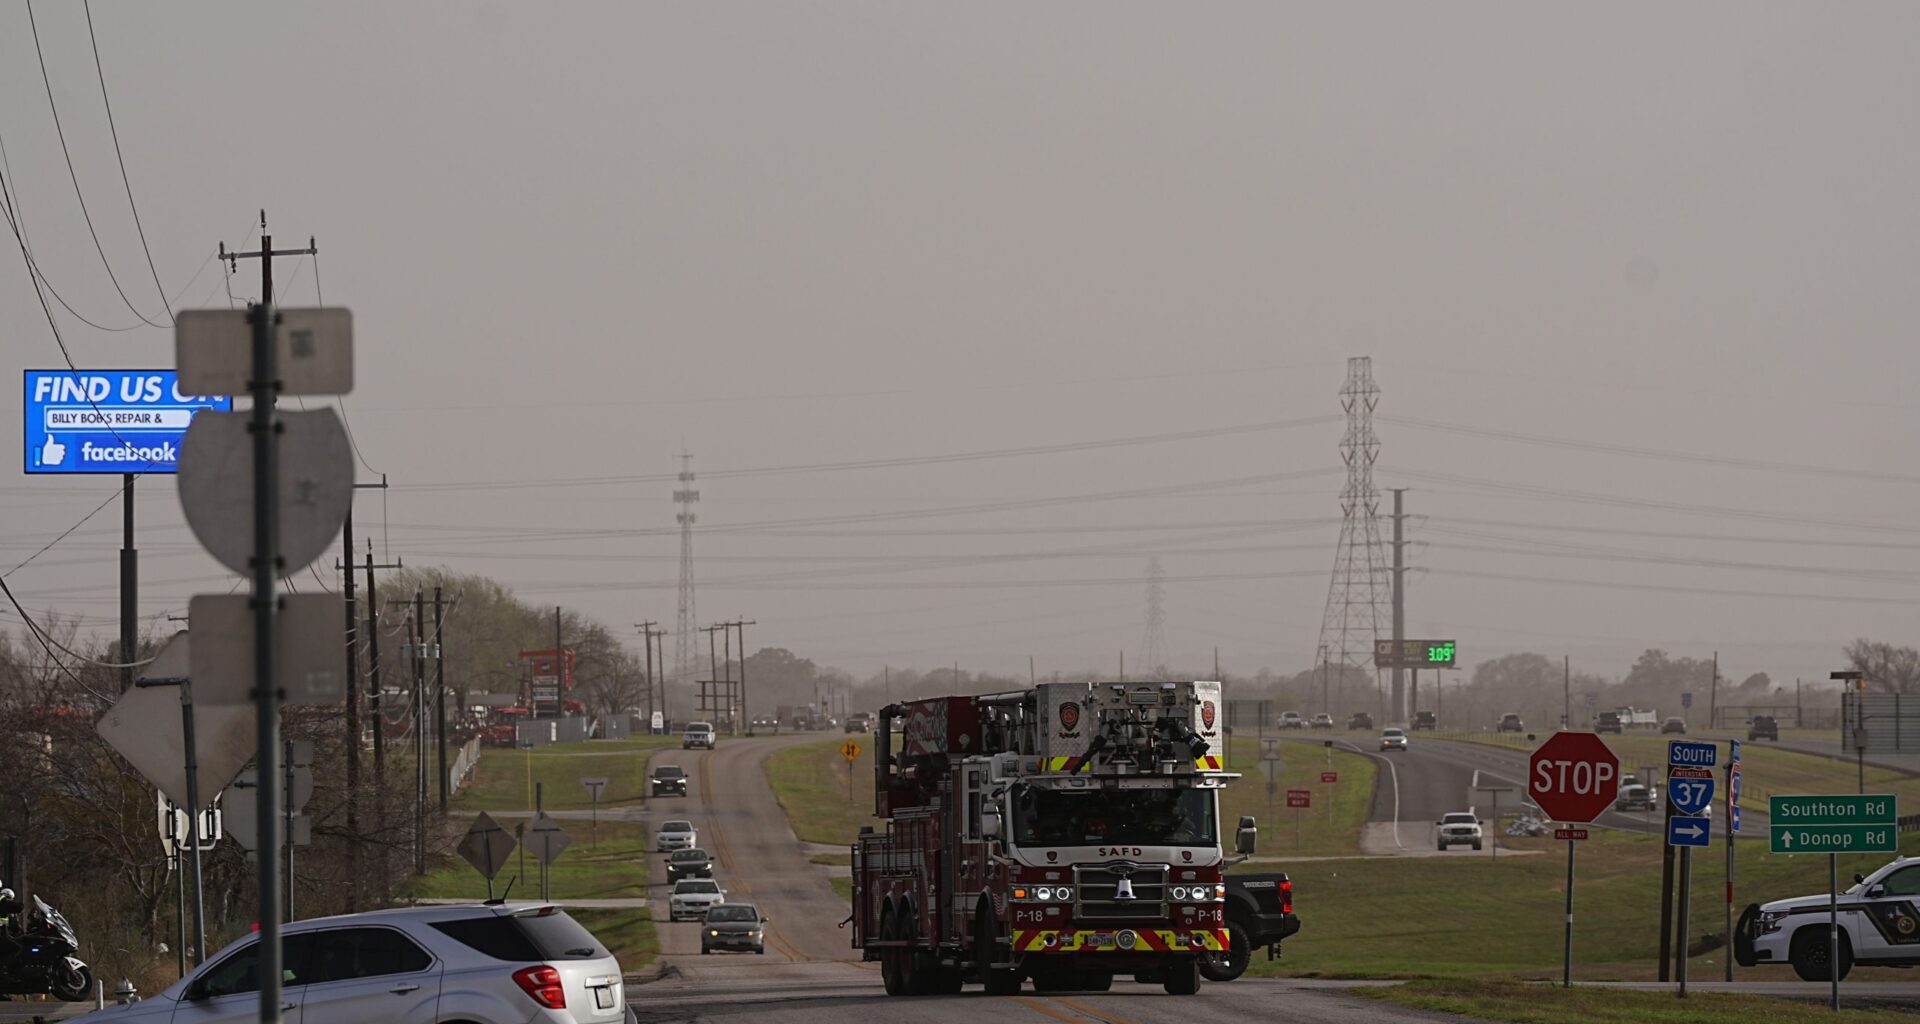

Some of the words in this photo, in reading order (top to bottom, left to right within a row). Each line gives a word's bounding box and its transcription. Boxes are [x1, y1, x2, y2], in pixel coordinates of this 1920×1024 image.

[34, 376, 110, 402] FIND
[120, 376, 162, 402] US
[52, 413, 78, 424] BILLY
[80, 413, 112, 424] BOB'S
[116, 413, 151, 424] REPAIR
[154, 413, 162, 424] &
[81, 441, 176, 462] facebook
[1672, 745, 1714, 763] SOUTH
[1534, 759, 1614, 795] STOP
[1675, 770, 1708, 778] INTERSTATE
[1676, 783, 1707, 806] 37
[1781, 802, 1856, 816] Southton
[1865, 801, 1885, 816] Rd
[1556, 830, 1569, 838] ALL
[1572, 830, 1586, 839] WAY
[1800, 832, 1852, 848] Donop
[1865, 831, 1886, 845] Rd
[1098, 847, 1142, 857] SAFD
[1017, 910, 1043, 922] P-18
[1198, 910, 1222, 921] P-18
